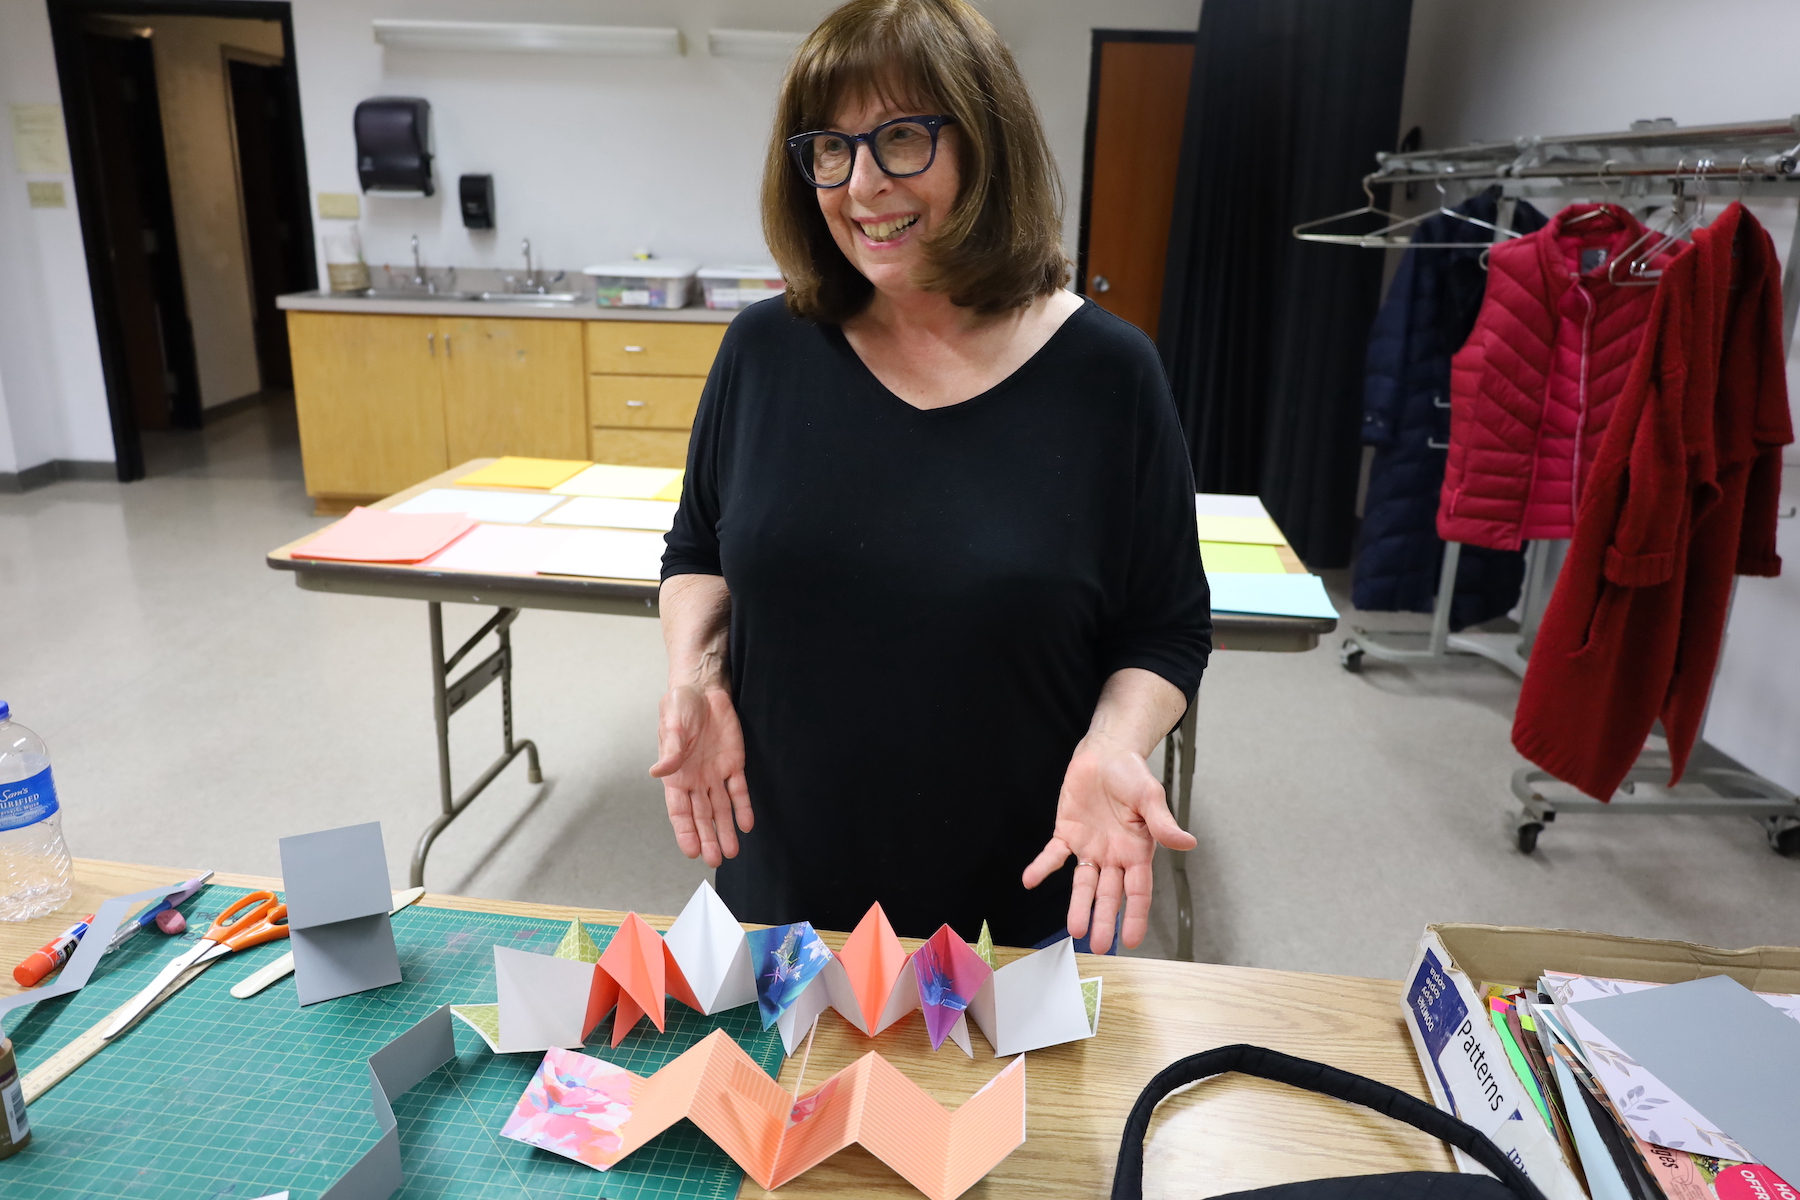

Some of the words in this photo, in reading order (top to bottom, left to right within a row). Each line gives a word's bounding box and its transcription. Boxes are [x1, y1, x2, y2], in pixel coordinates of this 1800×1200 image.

[0, 787, 29, 803] Sam's
[0, 793, 40, 809] URIFIED
[1425, 977, 1441, 999] copie
[1429, 967, 1446, 990] copia
[1417, 995, 1435, 1033] DOMTAR
[1457, 1019, 1504, 1111] Patterns
